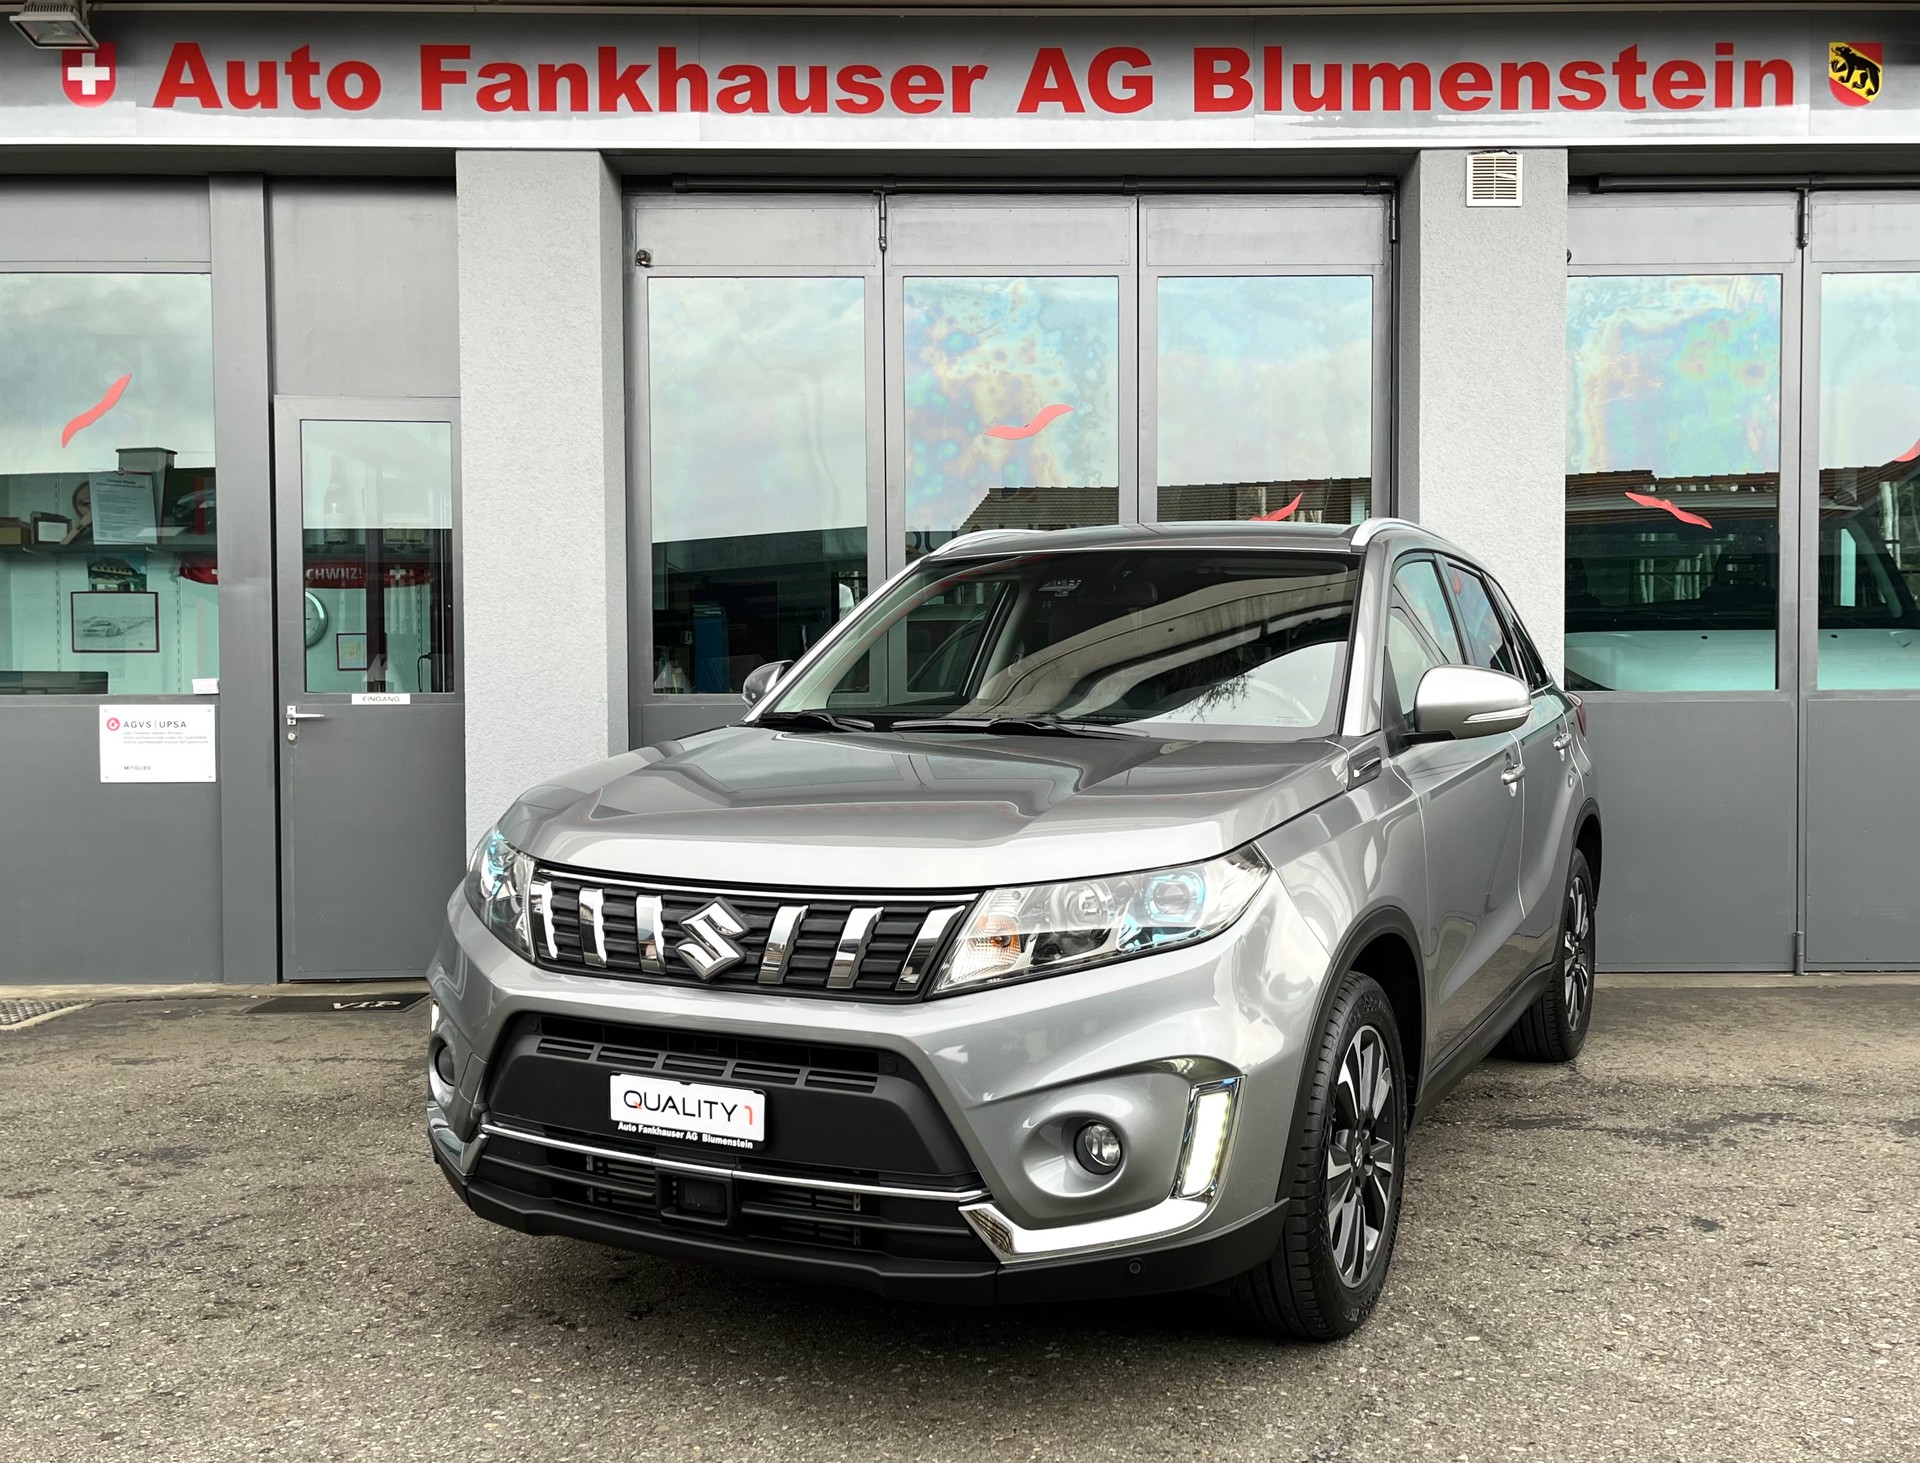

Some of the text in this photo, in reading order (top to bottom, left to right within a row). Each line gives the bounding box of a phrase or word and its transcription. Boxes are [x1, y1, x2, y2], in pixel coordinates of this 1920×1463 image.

[154, 43, 1795, 114] Auto Fankhauser AG Blumenstein
[306, 568, 363, 580] CHWIIZ!
[362, 695, 401, 703] EINGANG
[123, 720, 187, 729] AGVS UPSA
[617, 1121, 754, 1149] Auto Fankhauser AG Blumenstein
